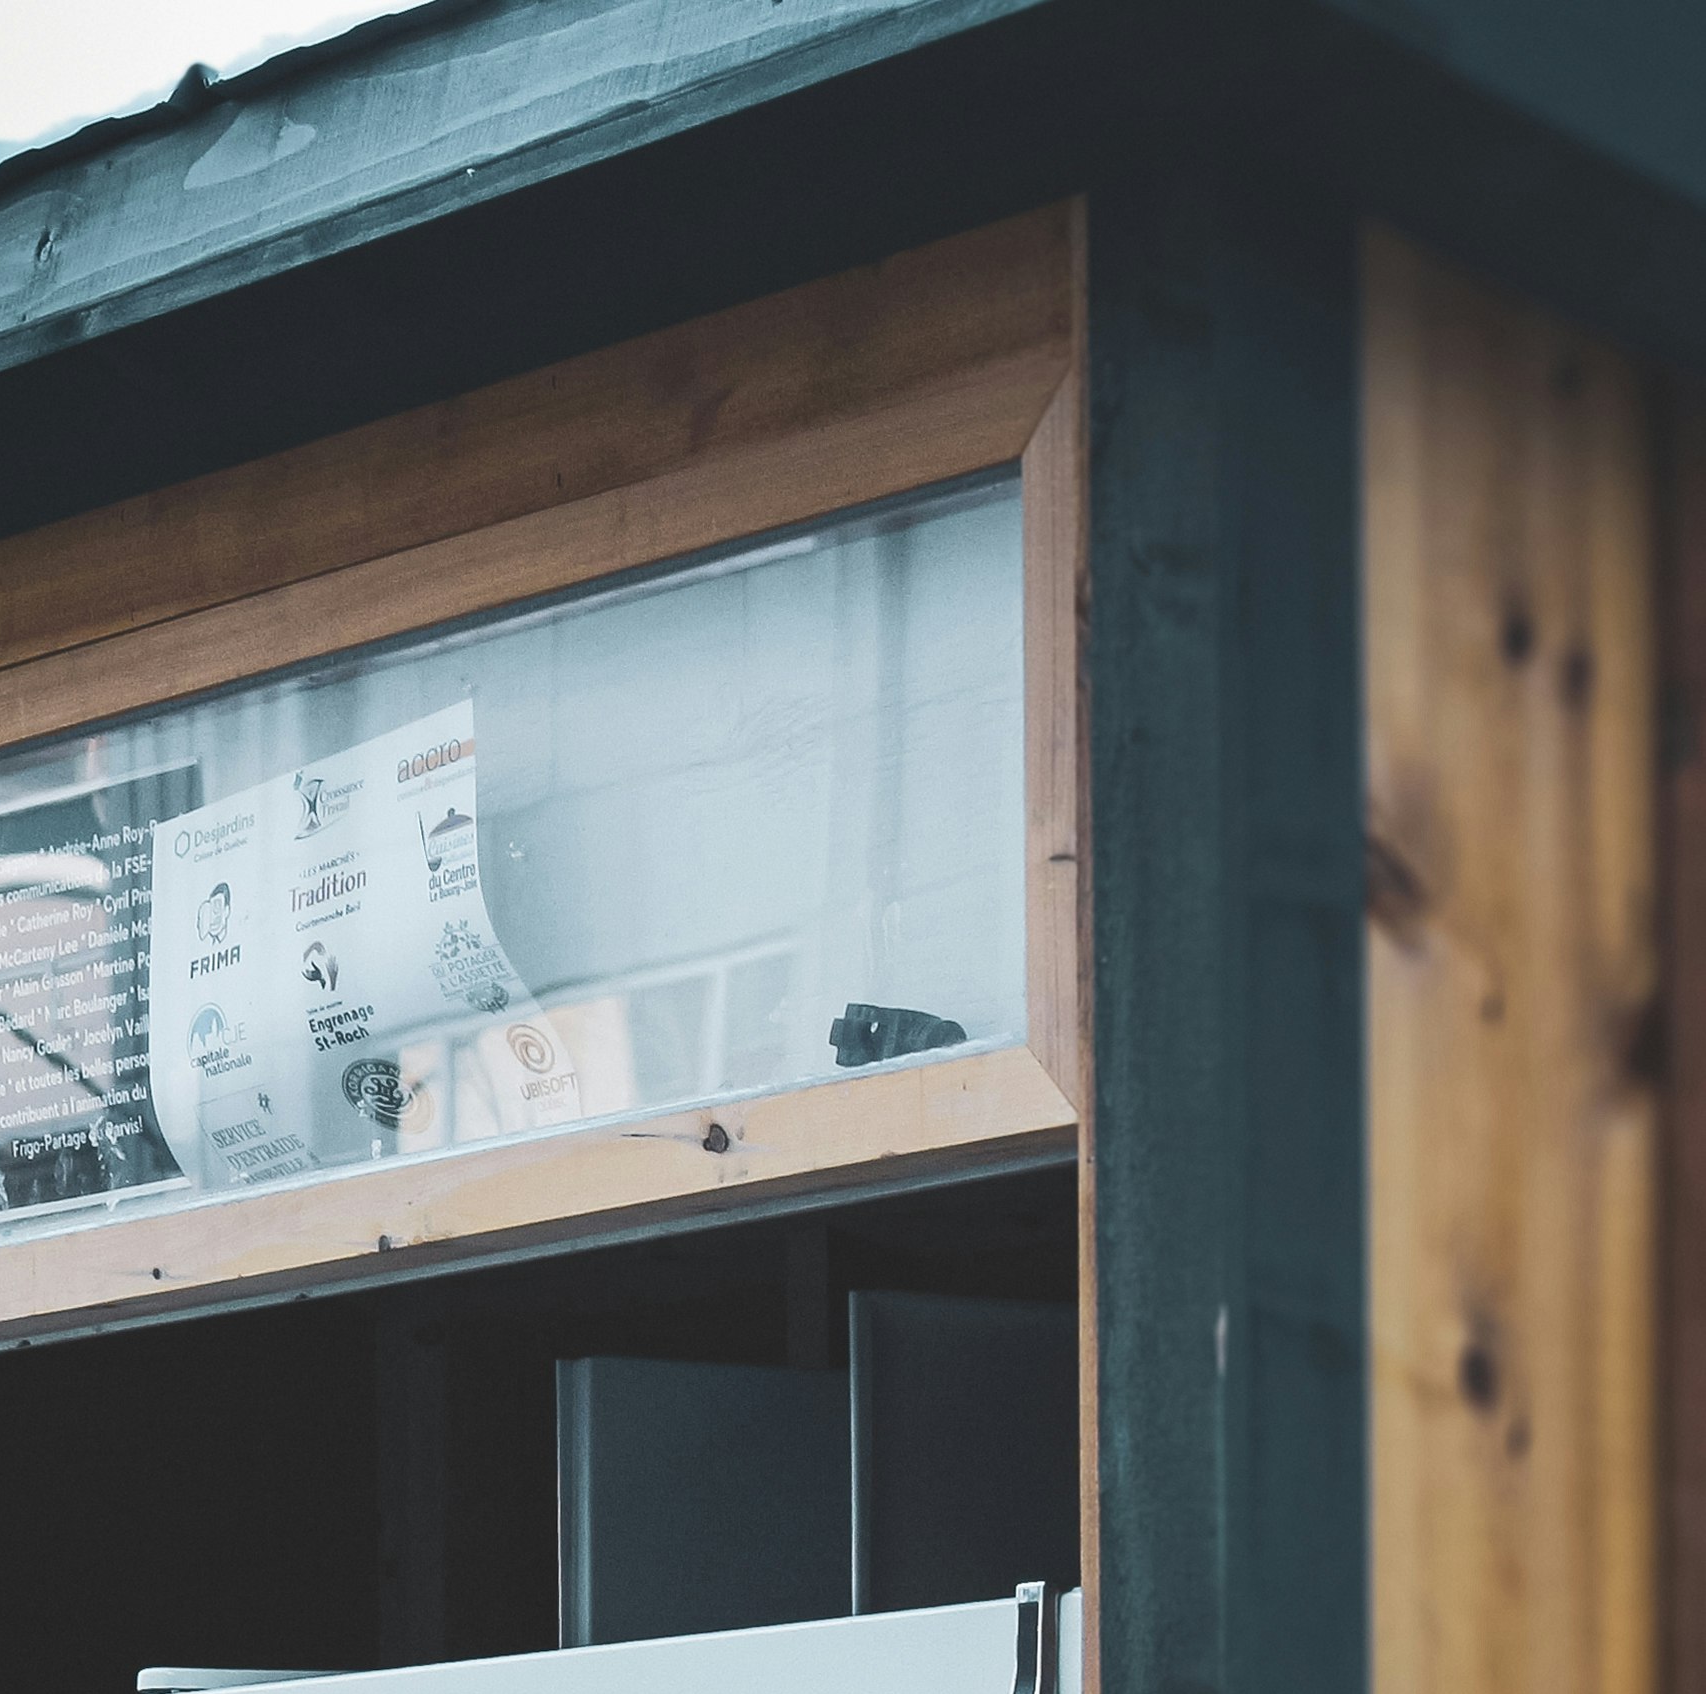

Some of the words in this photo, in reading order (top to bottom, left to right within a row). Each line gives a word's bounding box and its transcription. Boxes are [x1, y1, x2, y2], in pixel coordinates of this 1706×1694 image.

[397, 738, 461, 784] accro
[194, 812, 255, 847] Desjardins
[112, 862, 122, 879] la
[289, 869, 367, 913] Tradition
[18, 909, 70, 934] Catherine
[72, 903, 93, 922] Roy
[104, 891, 129, 914] Cyril
[59, 938, 79, 956] Lee
[88, 927, 129, 949] Danièle
[190, 945, 241, 979] FRIMA
[13, 977, 39, 998] Alain
[93, 957, 134, 980] Martine
[74, 992, 128, 1017] Boulanger
[309, 1004, 375, 1033] Engrenage
[2, 1045, 34, 1067] Nancy
[82, 1022, 124, 1047] Jocelyn
[222, 1022, 247, 1046] CJE
[315, 1025, 370, 1051] St-Roch
[190, 1047, 230, 1069] capitale
[205, 1053, 252, 1078] nationale
[15, 1079, 26, 1093] et
[28, 1070, 62, 1090] toutes
[64, 1064, 80, 1083] les
[81, 1058, 113, 1080] belles
[520, 1072, 577, 1101] UBISOFT
[0, 1100, 59, 1129] contribuent
[62, 1099, 68, 1116] à
[131, 1083, 147, 1100] du
[12, 1130, 86, 1160] Frigo-Partage
[211, 1119, 266, 1148] SERVICE
[226, 1133, 305, 1170] D'ENTRAIDE
